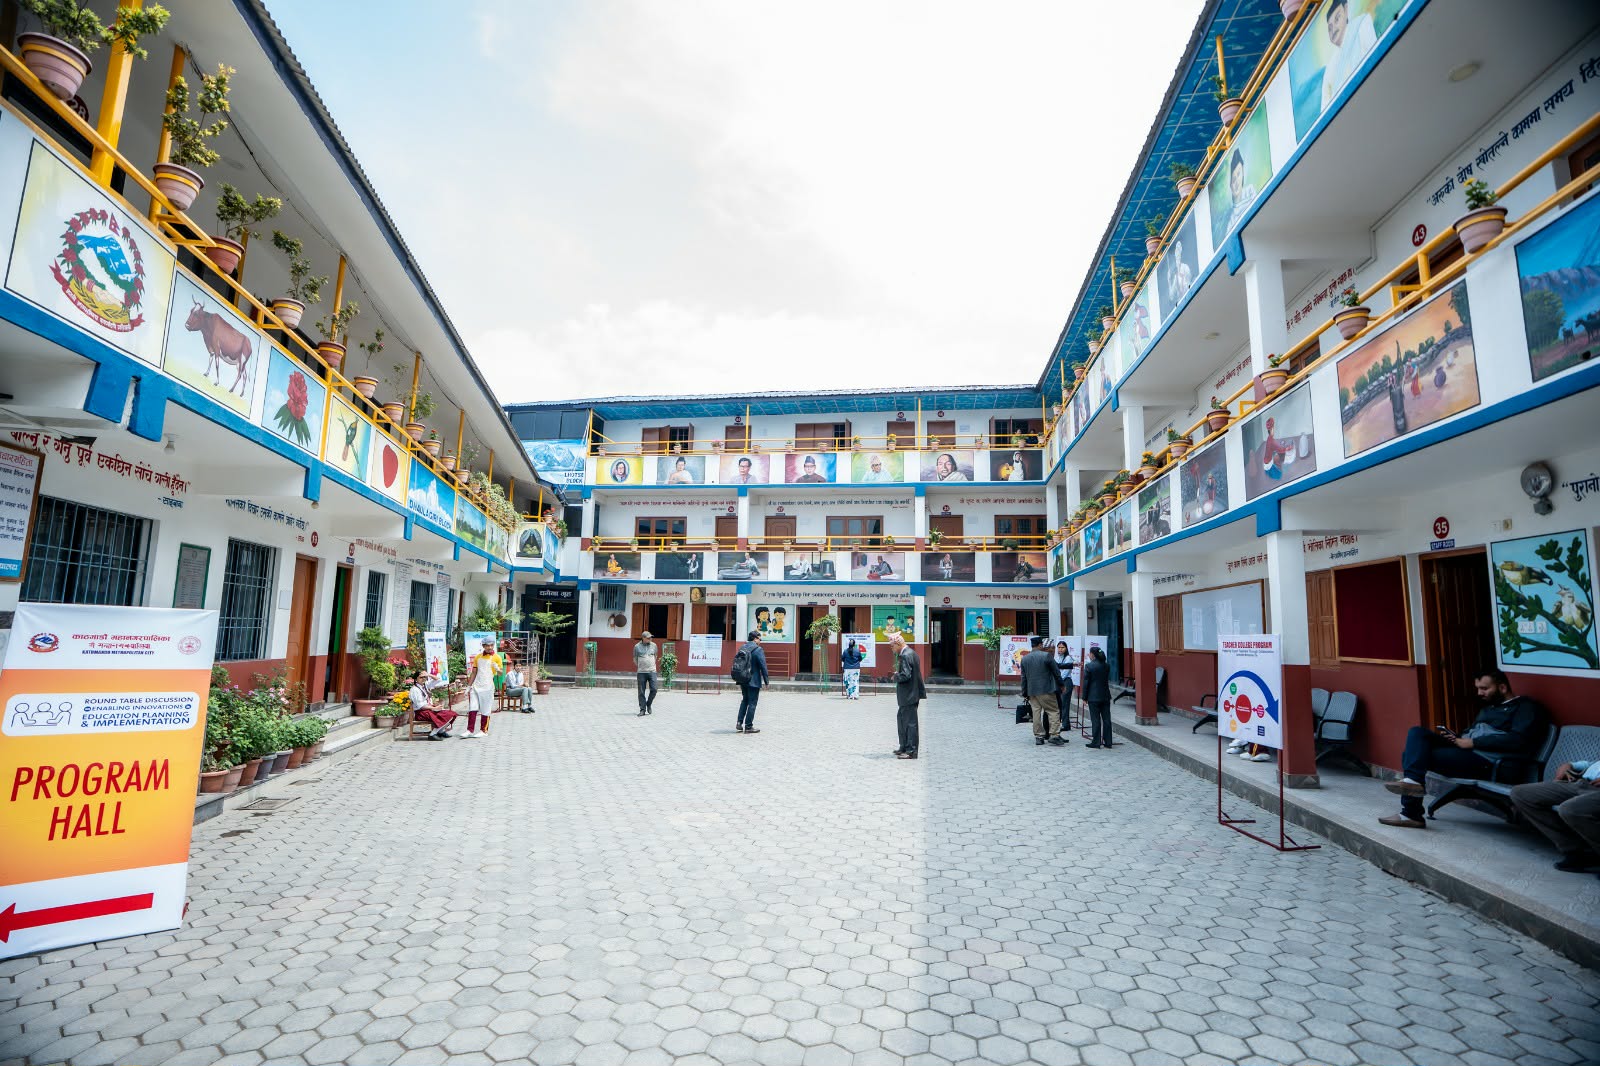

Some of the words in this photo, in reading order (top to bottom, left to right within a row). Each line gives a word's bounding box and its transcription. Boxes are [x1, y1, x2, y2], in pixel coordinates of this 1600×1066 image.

[1511, 106, 1541, 140] काममा
[1543, 79, 1575, 115] समय
[1414, 227, 1424, 243] 43
[1435, 520, 1447, 535] 35
[1431, 540, 1443, 549] STAFF
[1443, 539, 1455, 548] ROOM
[560, 590, 573, 598] गृह
[82, 712, 139, 720] EDUCATION
[93, 717, 190, 727] IMPLEMENTATION
[10, 758, 170, 802] PROGRAM
[48, 801, 126, 841] HALL
